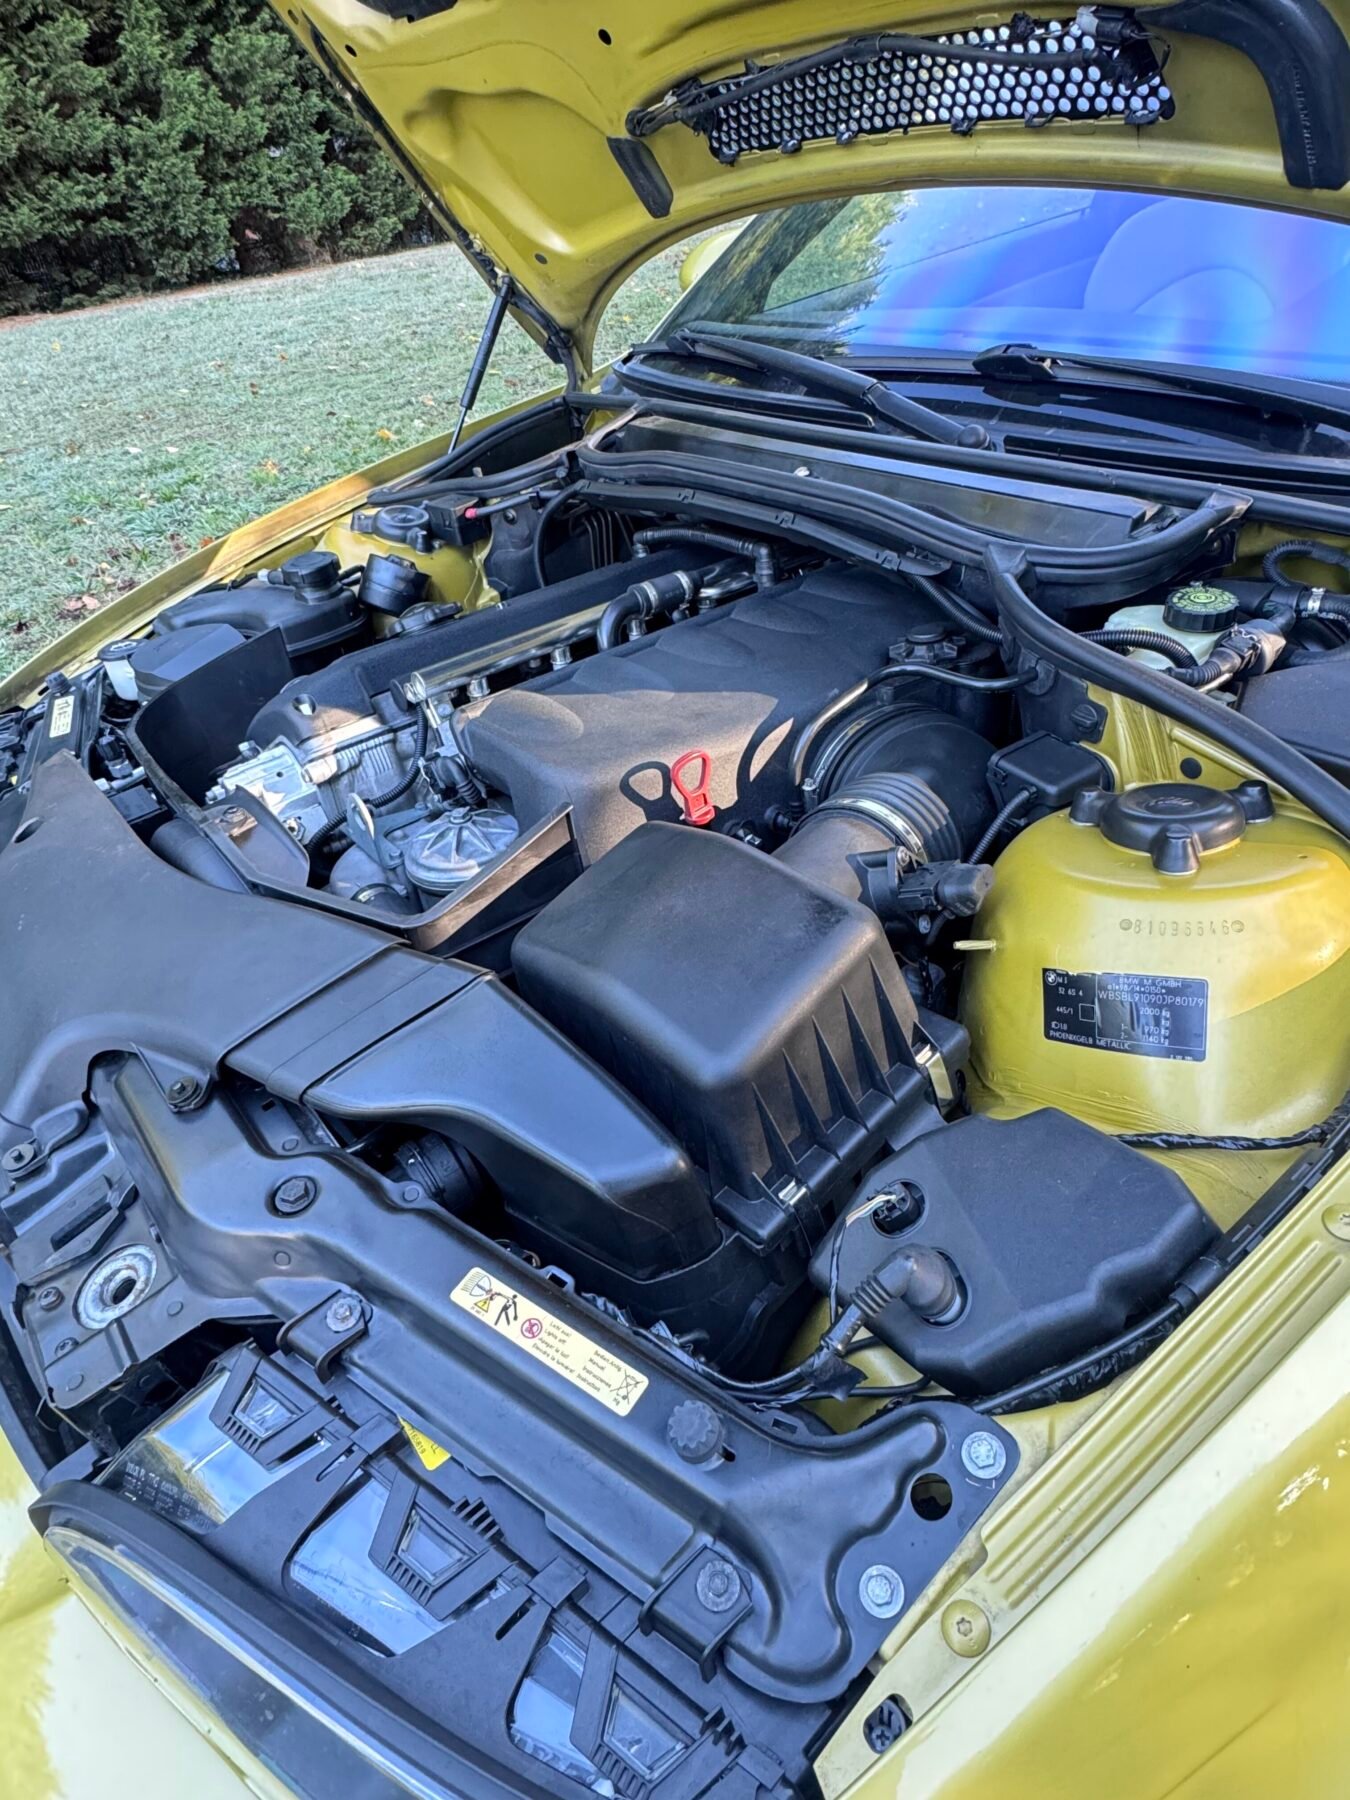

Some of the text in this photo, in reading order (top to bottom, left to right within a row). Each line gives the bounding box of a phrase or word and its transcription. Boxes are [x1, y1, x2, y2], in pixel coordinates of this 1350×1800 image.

[1119, 976, 1139, 985] BMW
[1155, 979, 1182, 988] GMBH
[1098, 990, 1204, 1008] WBSBL91090JP80179
[1139, 1007, 1160, 1016] 2000
[1049, 1030, 1131, 1050] PHOENIXGELB METALLIC
